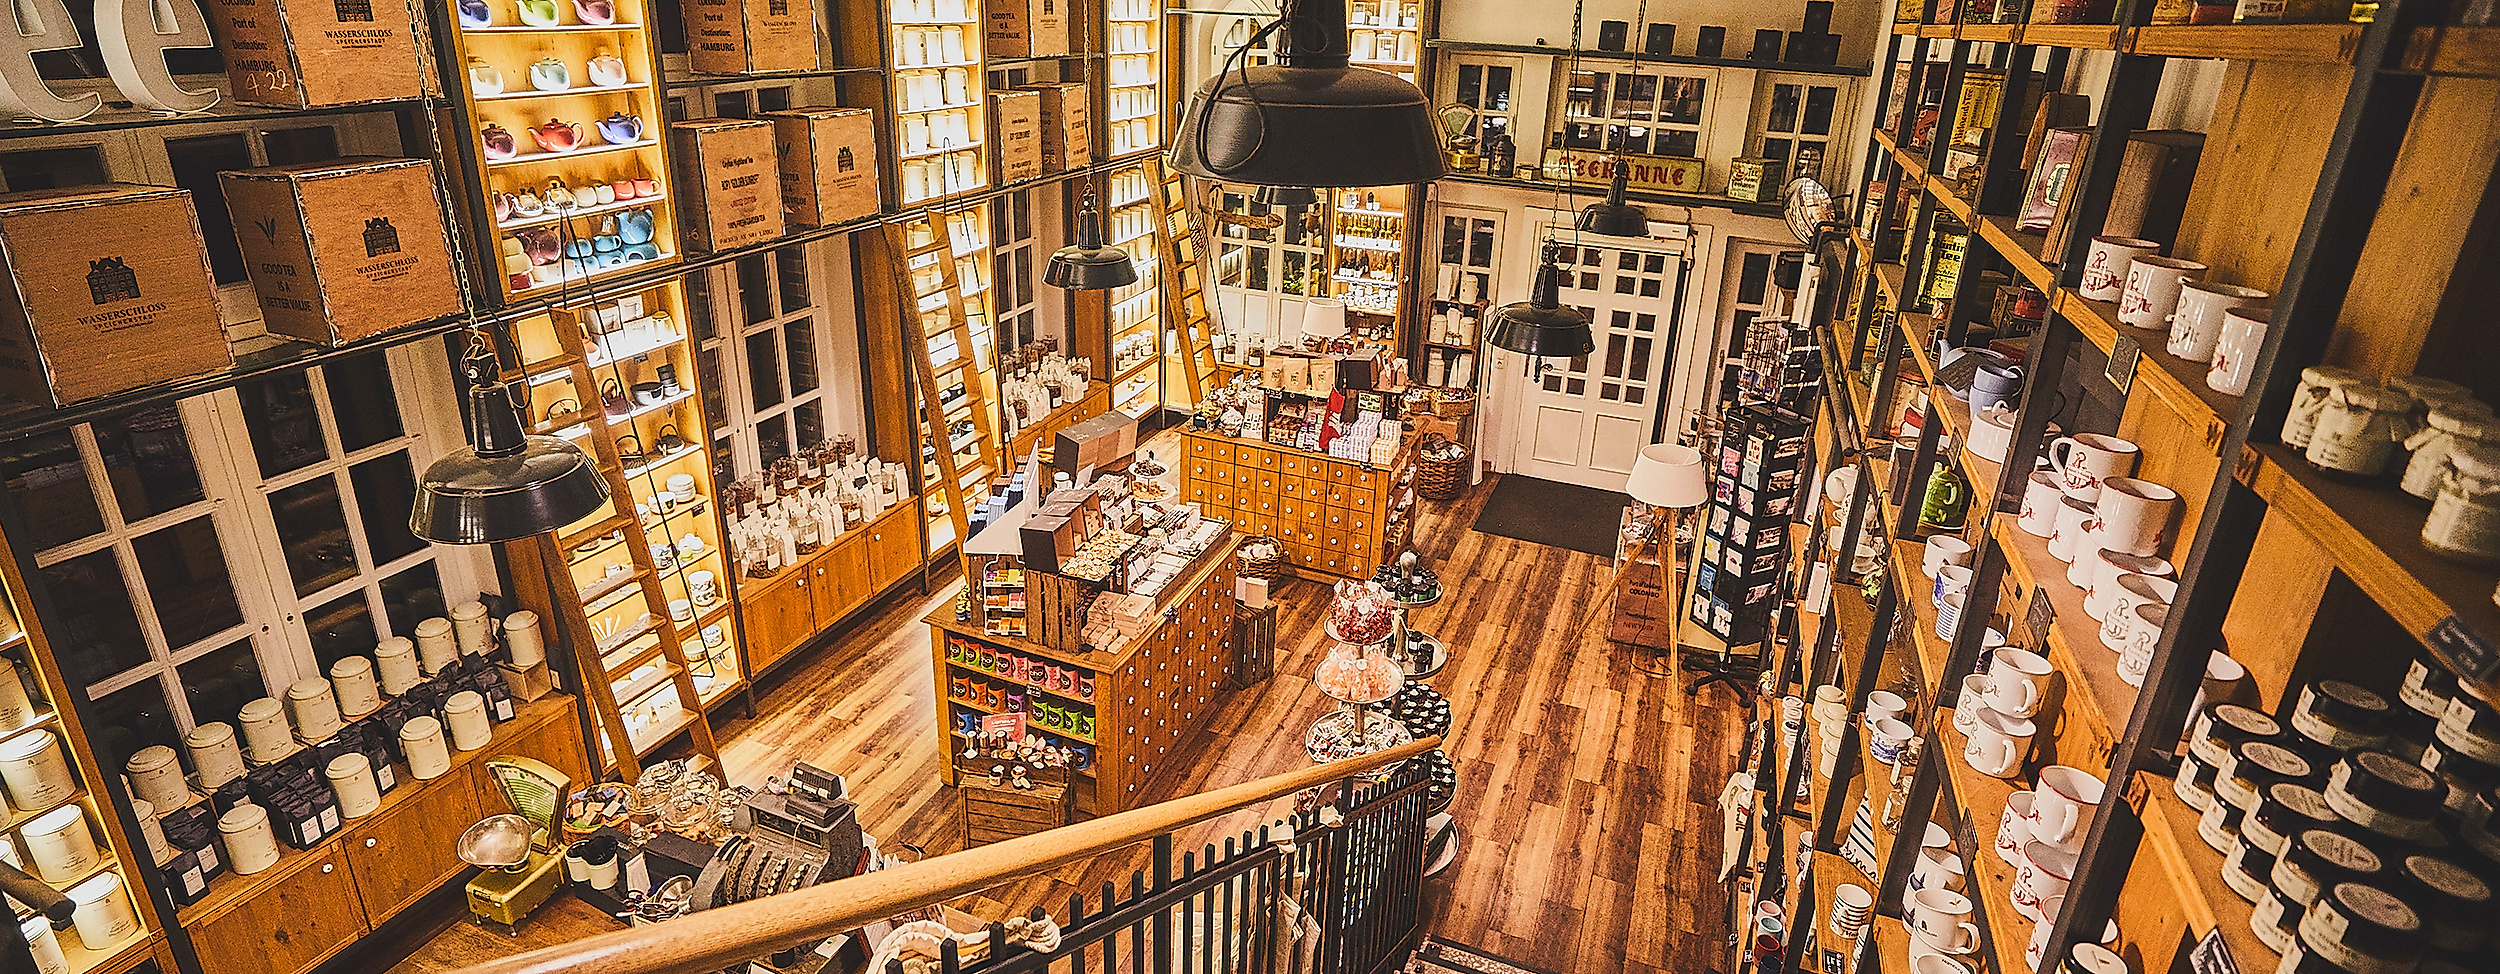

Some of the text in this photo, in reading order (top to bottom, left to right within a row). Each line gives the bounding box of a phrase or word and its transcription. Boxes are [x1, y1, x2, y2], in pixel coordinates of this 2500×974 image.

[232, 17, 257, 29] Port of
[324, 29, 393, 39] WASSERSCHLOSS
[700, 42, 735, 52] HAMBURG
[234, 59, 276, 72] HAMBURG
[1940, 250, 1961, 262] Tee
[262, 263, 297, 277] GOOD TEA
[356, 256, 419, 275] WASSERSCHLOSS
[77, 302, 167, 326] WASSERSCHLOSS
